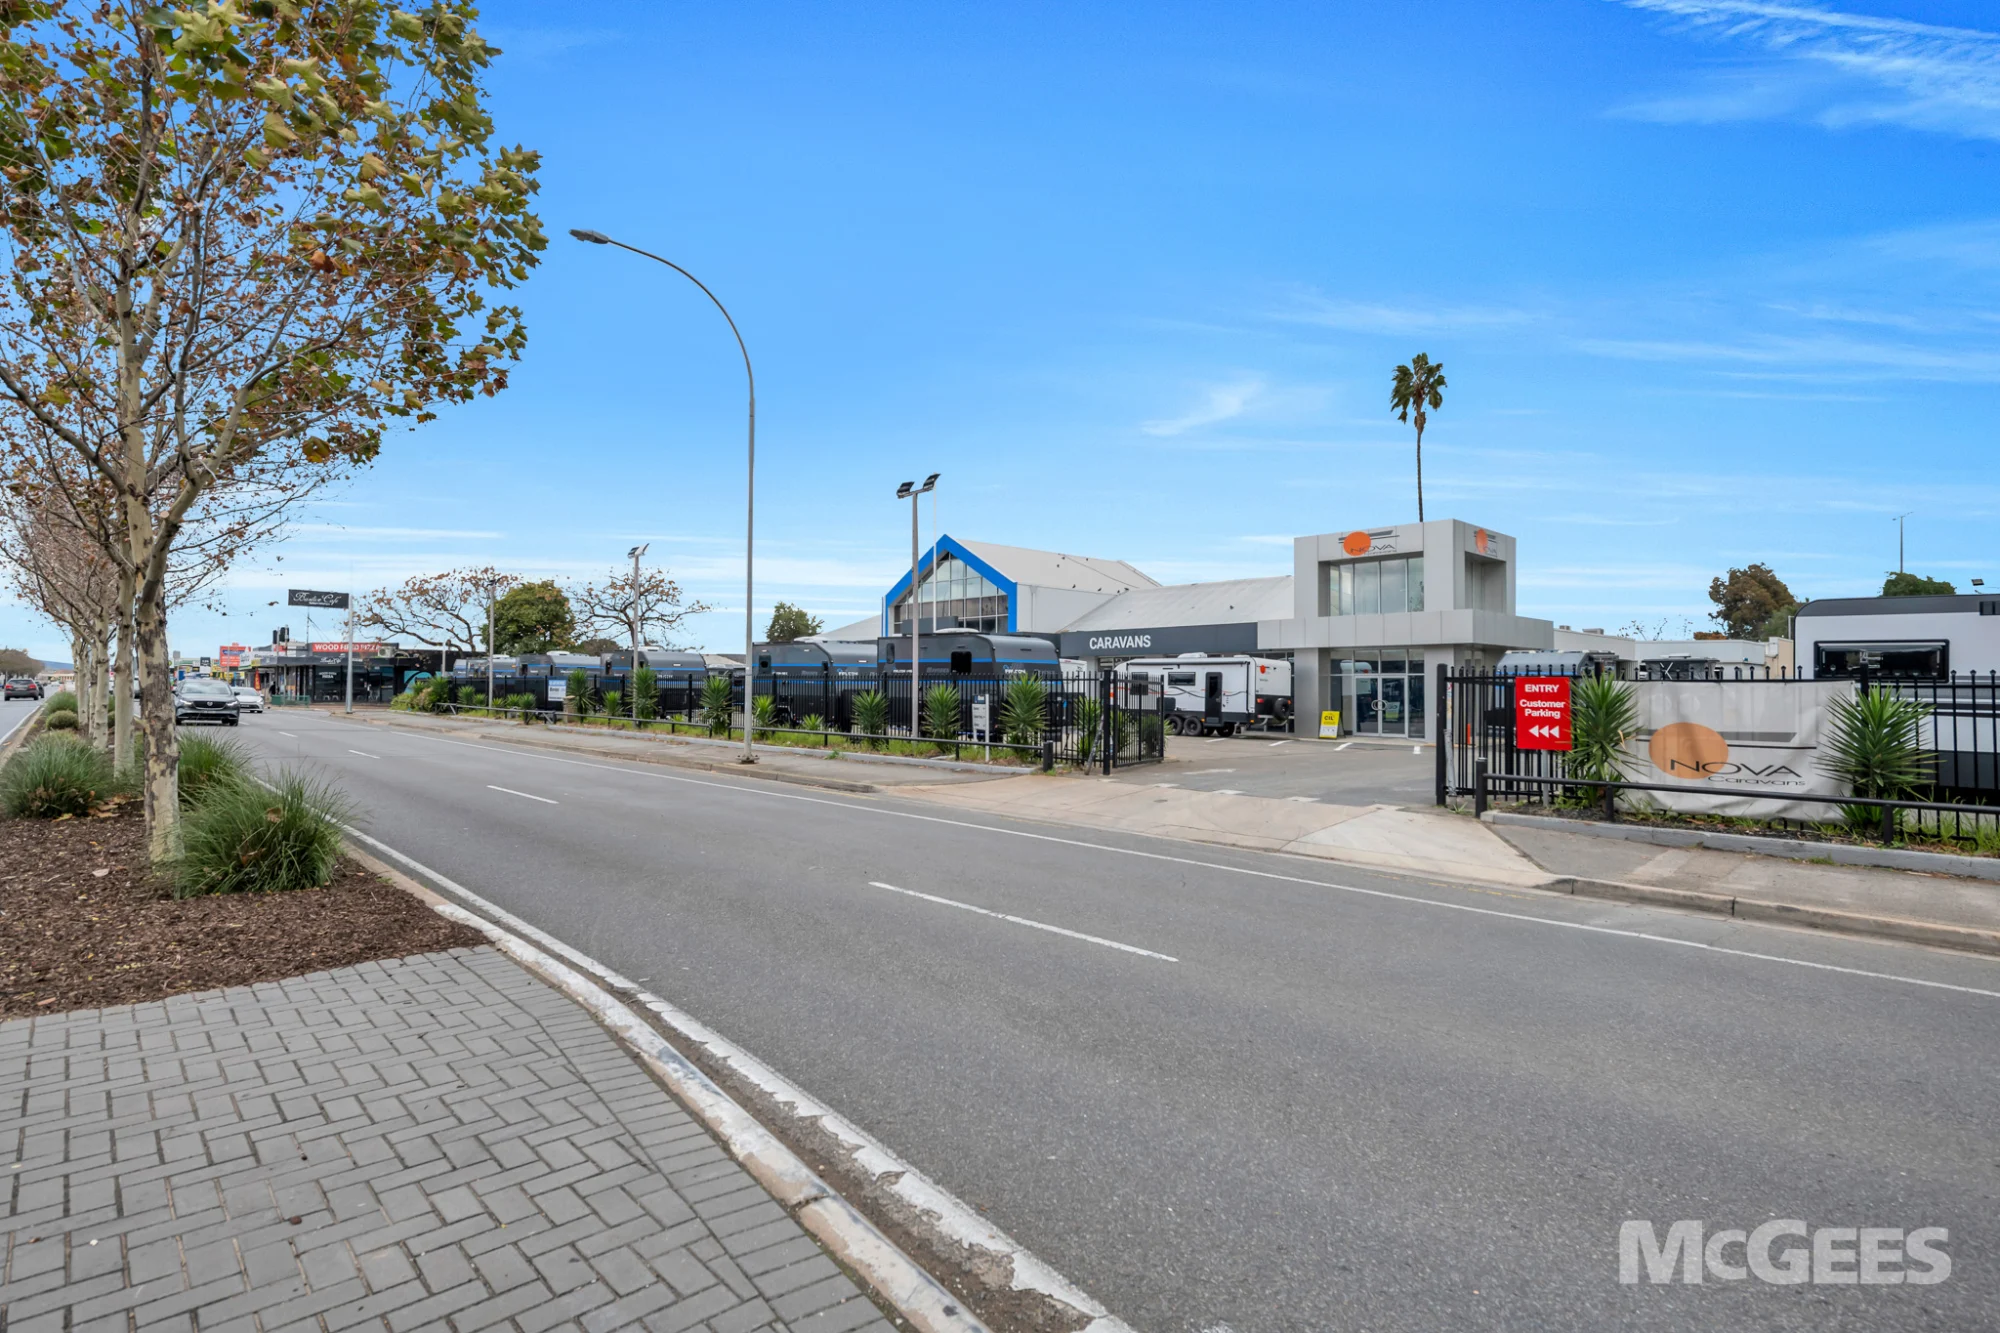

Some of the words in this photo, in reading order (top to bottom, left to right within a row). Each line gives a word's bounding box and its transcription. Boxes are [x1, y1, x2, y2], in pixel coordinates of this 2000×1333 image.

[1350, 544, 1396, 554] NOVA
[1089, 635, 1152, 650] CARAVANS
[1525, 684, 1560, 693] ENTRY
[1519, 699, 1566, 708] Customer
[1525, 709, 1561, 719] Parking
[1670, 759, 1803, 778] NOVA
[1708, 776, 1806, 786] Caravans
